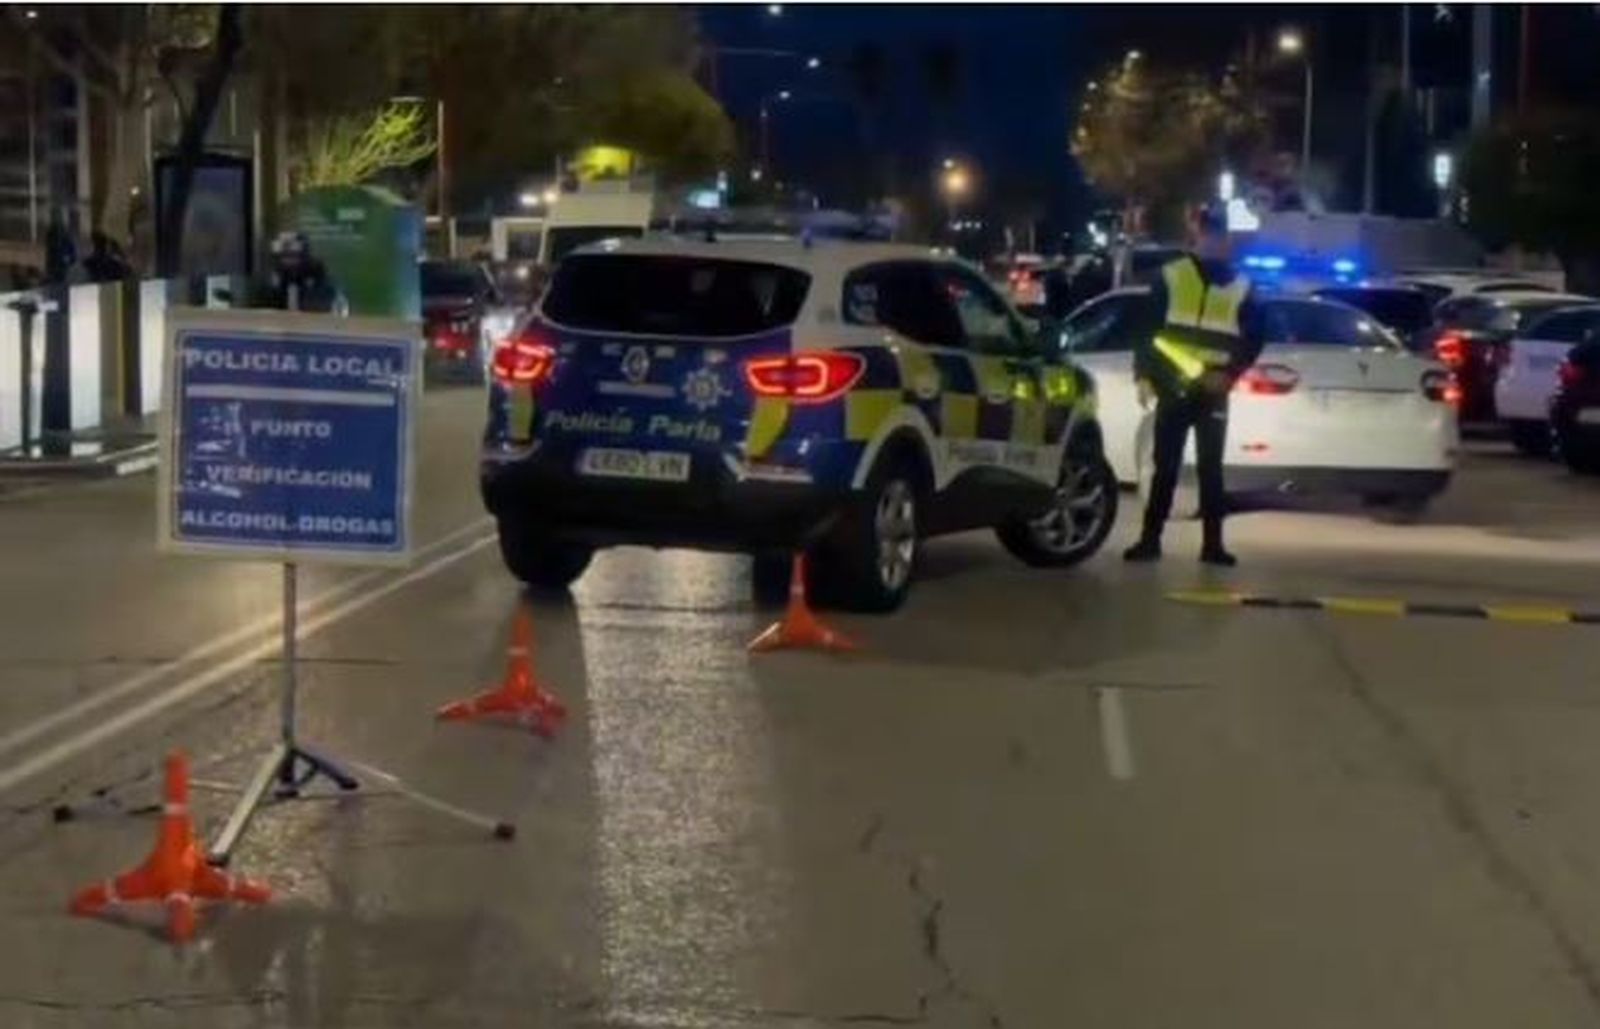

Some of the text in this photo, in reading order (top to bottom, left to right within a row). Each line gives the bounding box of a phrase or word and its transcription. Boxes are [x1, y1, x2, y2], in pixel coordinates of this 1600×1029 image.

[185, 349, 396, 377] POLICIA LOCAL
[250, 419, 332, 438] PUNTO
[648, 415, 721, 441] Parla
